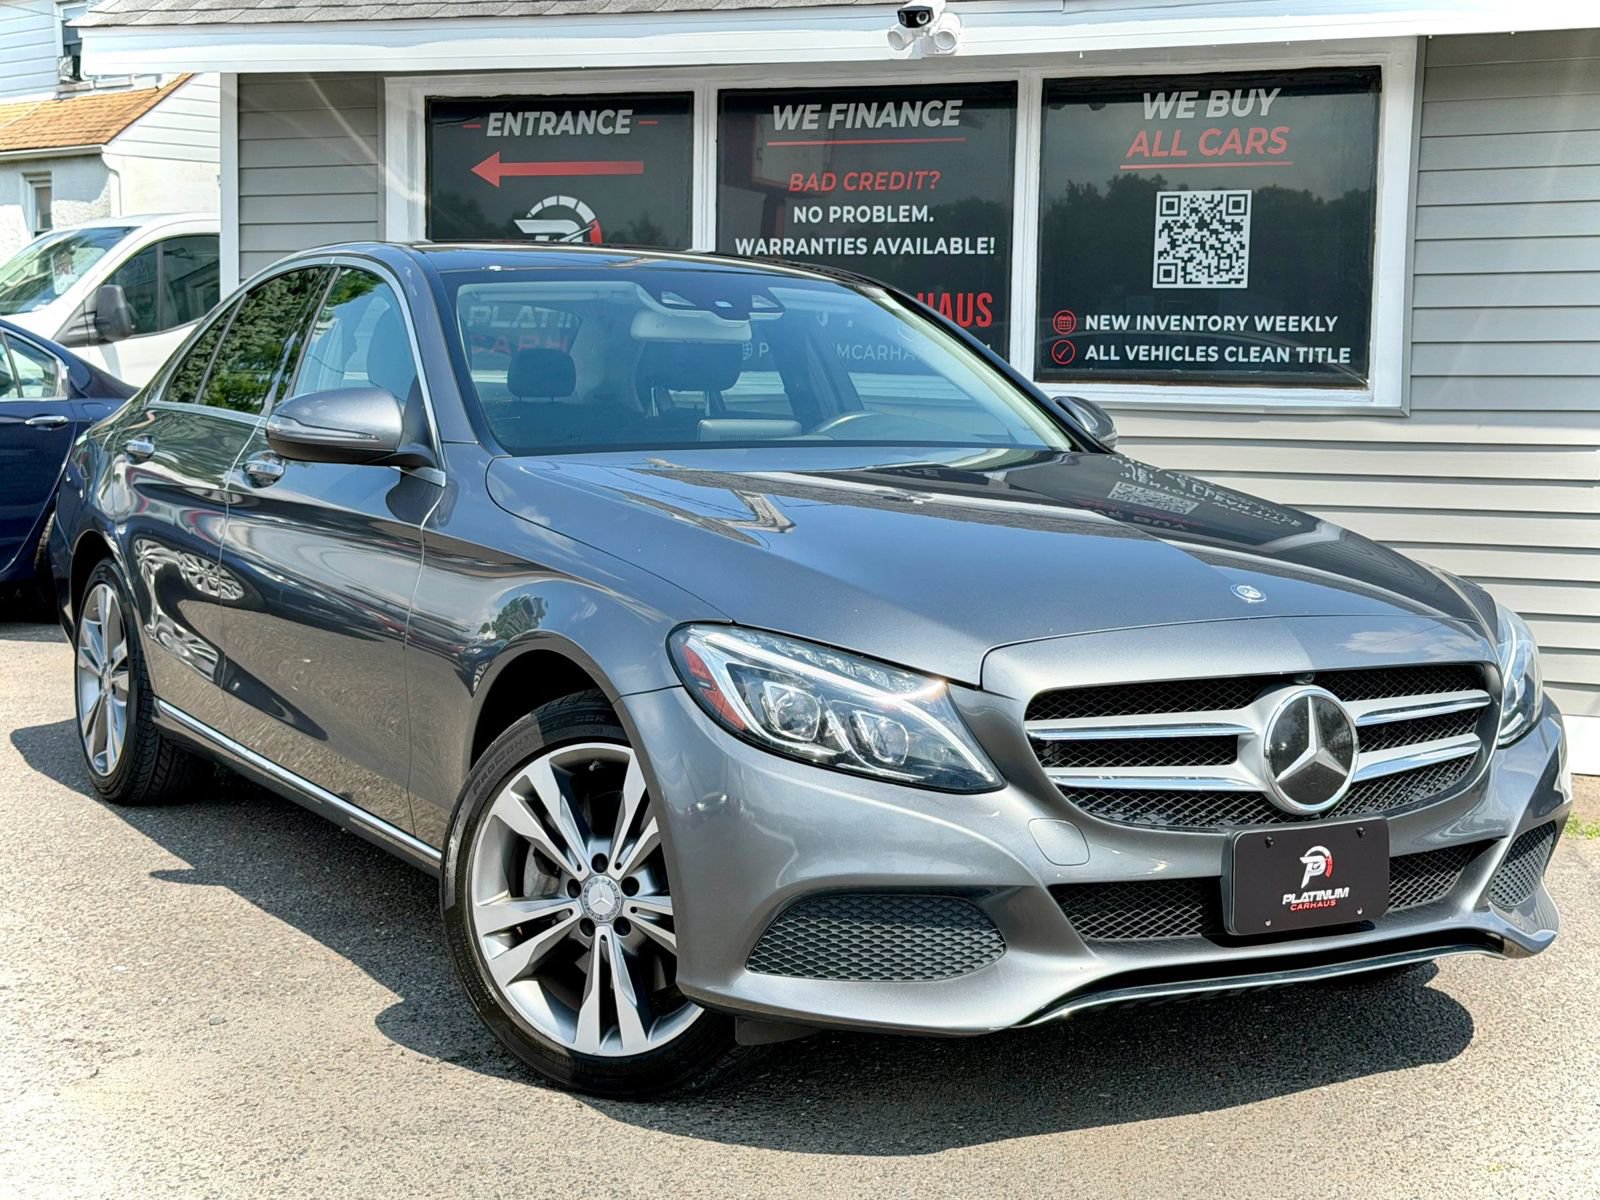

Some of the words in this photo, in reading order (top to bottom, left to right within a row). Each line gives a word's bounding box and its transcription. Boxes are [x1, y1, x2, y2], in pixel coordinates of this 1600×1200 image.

[1143, 91, 1199, 120] WE
[1205, 87, 1281, 118] BUY
[486, 109, 633, 137] ENTRANCE
[773, 103, 821, 131] WE
[828, 99, 963, 129] FINANCE
[1126, 129, 1188, 158] ALL
[1198, 126, 1290, 156] CARS
[788, 171, 837, 192] BAD
[843, 171, 942, 191] CREDIT?
[793, 205, 823, 223] NO
[829, 204, 935, 223] PROBLEM.
[735, 237, 868, 256] WARRANTIES
[873, 236, 996, 255] AVAILABLE!
[1085, 314, 1131, 331] NEW
[1136, 314, 1249, 332] INVENTORY
[1254, 314, 1339, 332] WEEKLY
[1085, 344, 1120, 361] ALL
[1125, 344, 1219, 363] VEHICLES
[1224, 345, 1290, 363] CLEAN
[1295, 346, 1351, 364] TITLE
[1282, 887, 1350, 905] PLATINUM
[1290, 898, 1337, 911] CARHAUS
